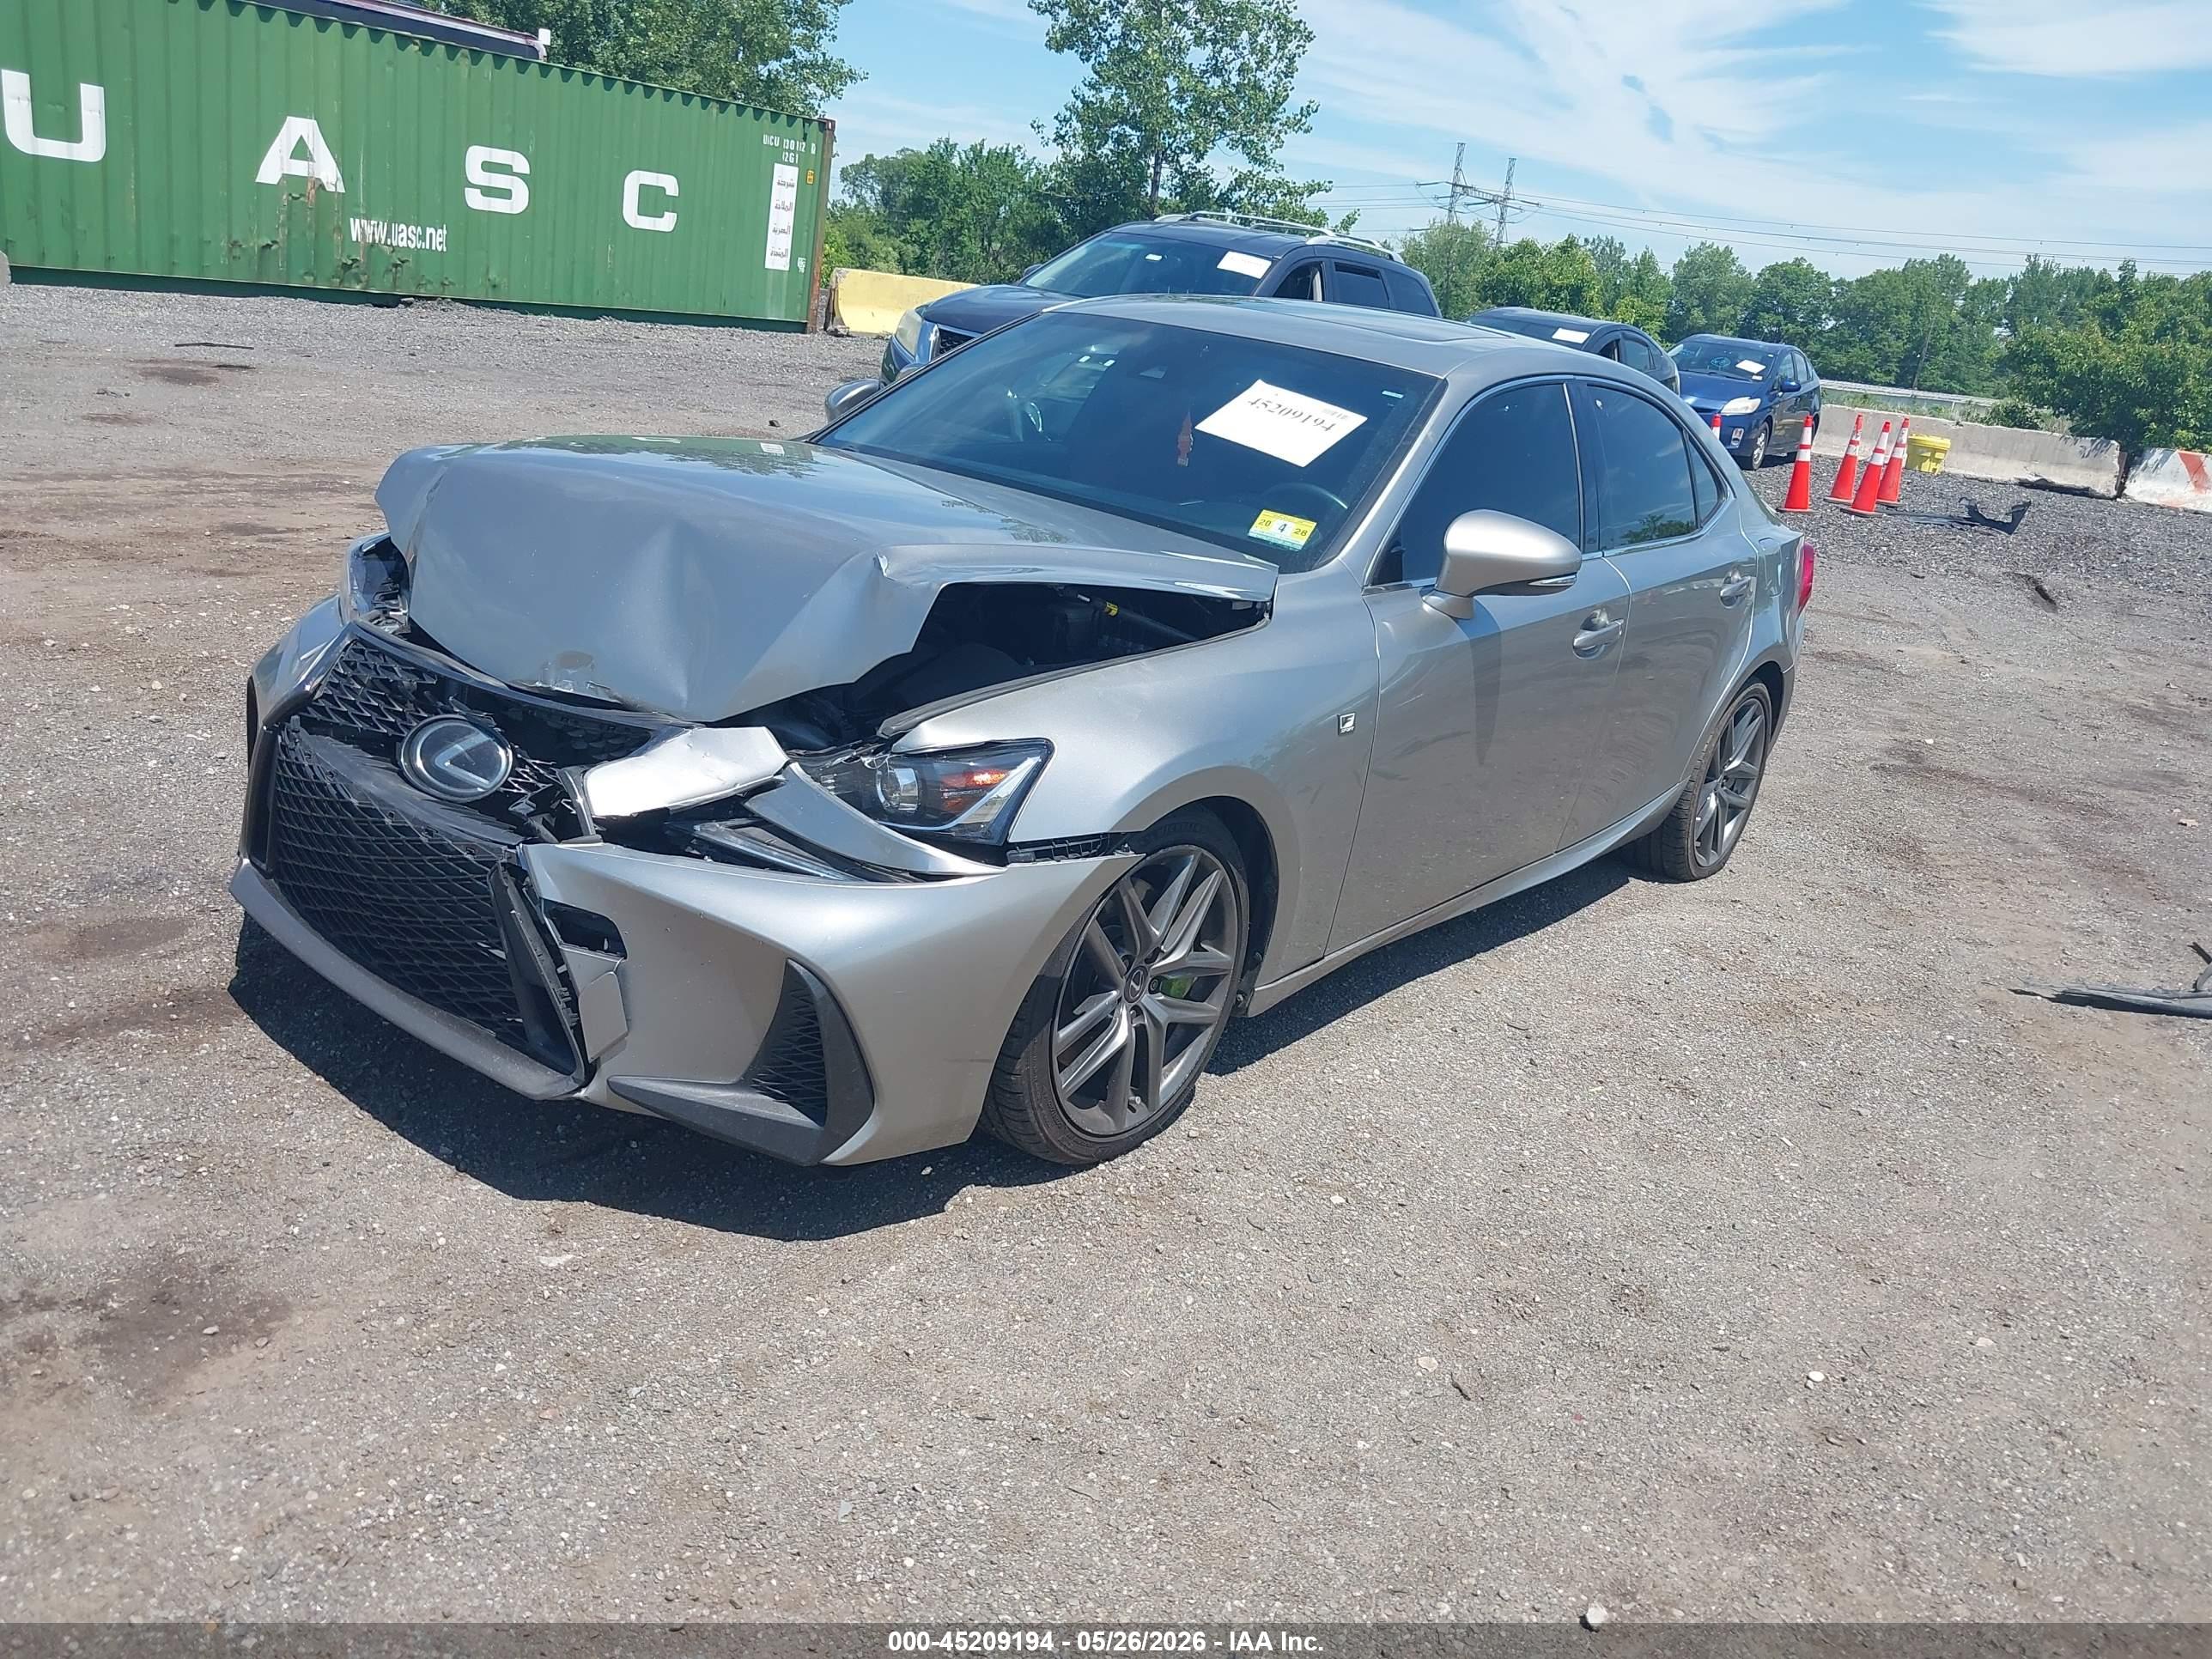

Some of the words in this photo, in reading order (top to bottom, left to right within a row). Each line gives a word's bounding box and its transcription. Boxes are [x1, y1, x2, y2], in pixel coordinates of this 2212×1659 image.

[349, 217, 447, 252] www.uasc.net
[1247, 398, 1337, 432] 45209194
[1258, 519, 1272, 527] 20
[1278, 523, 1288, 533] 4
